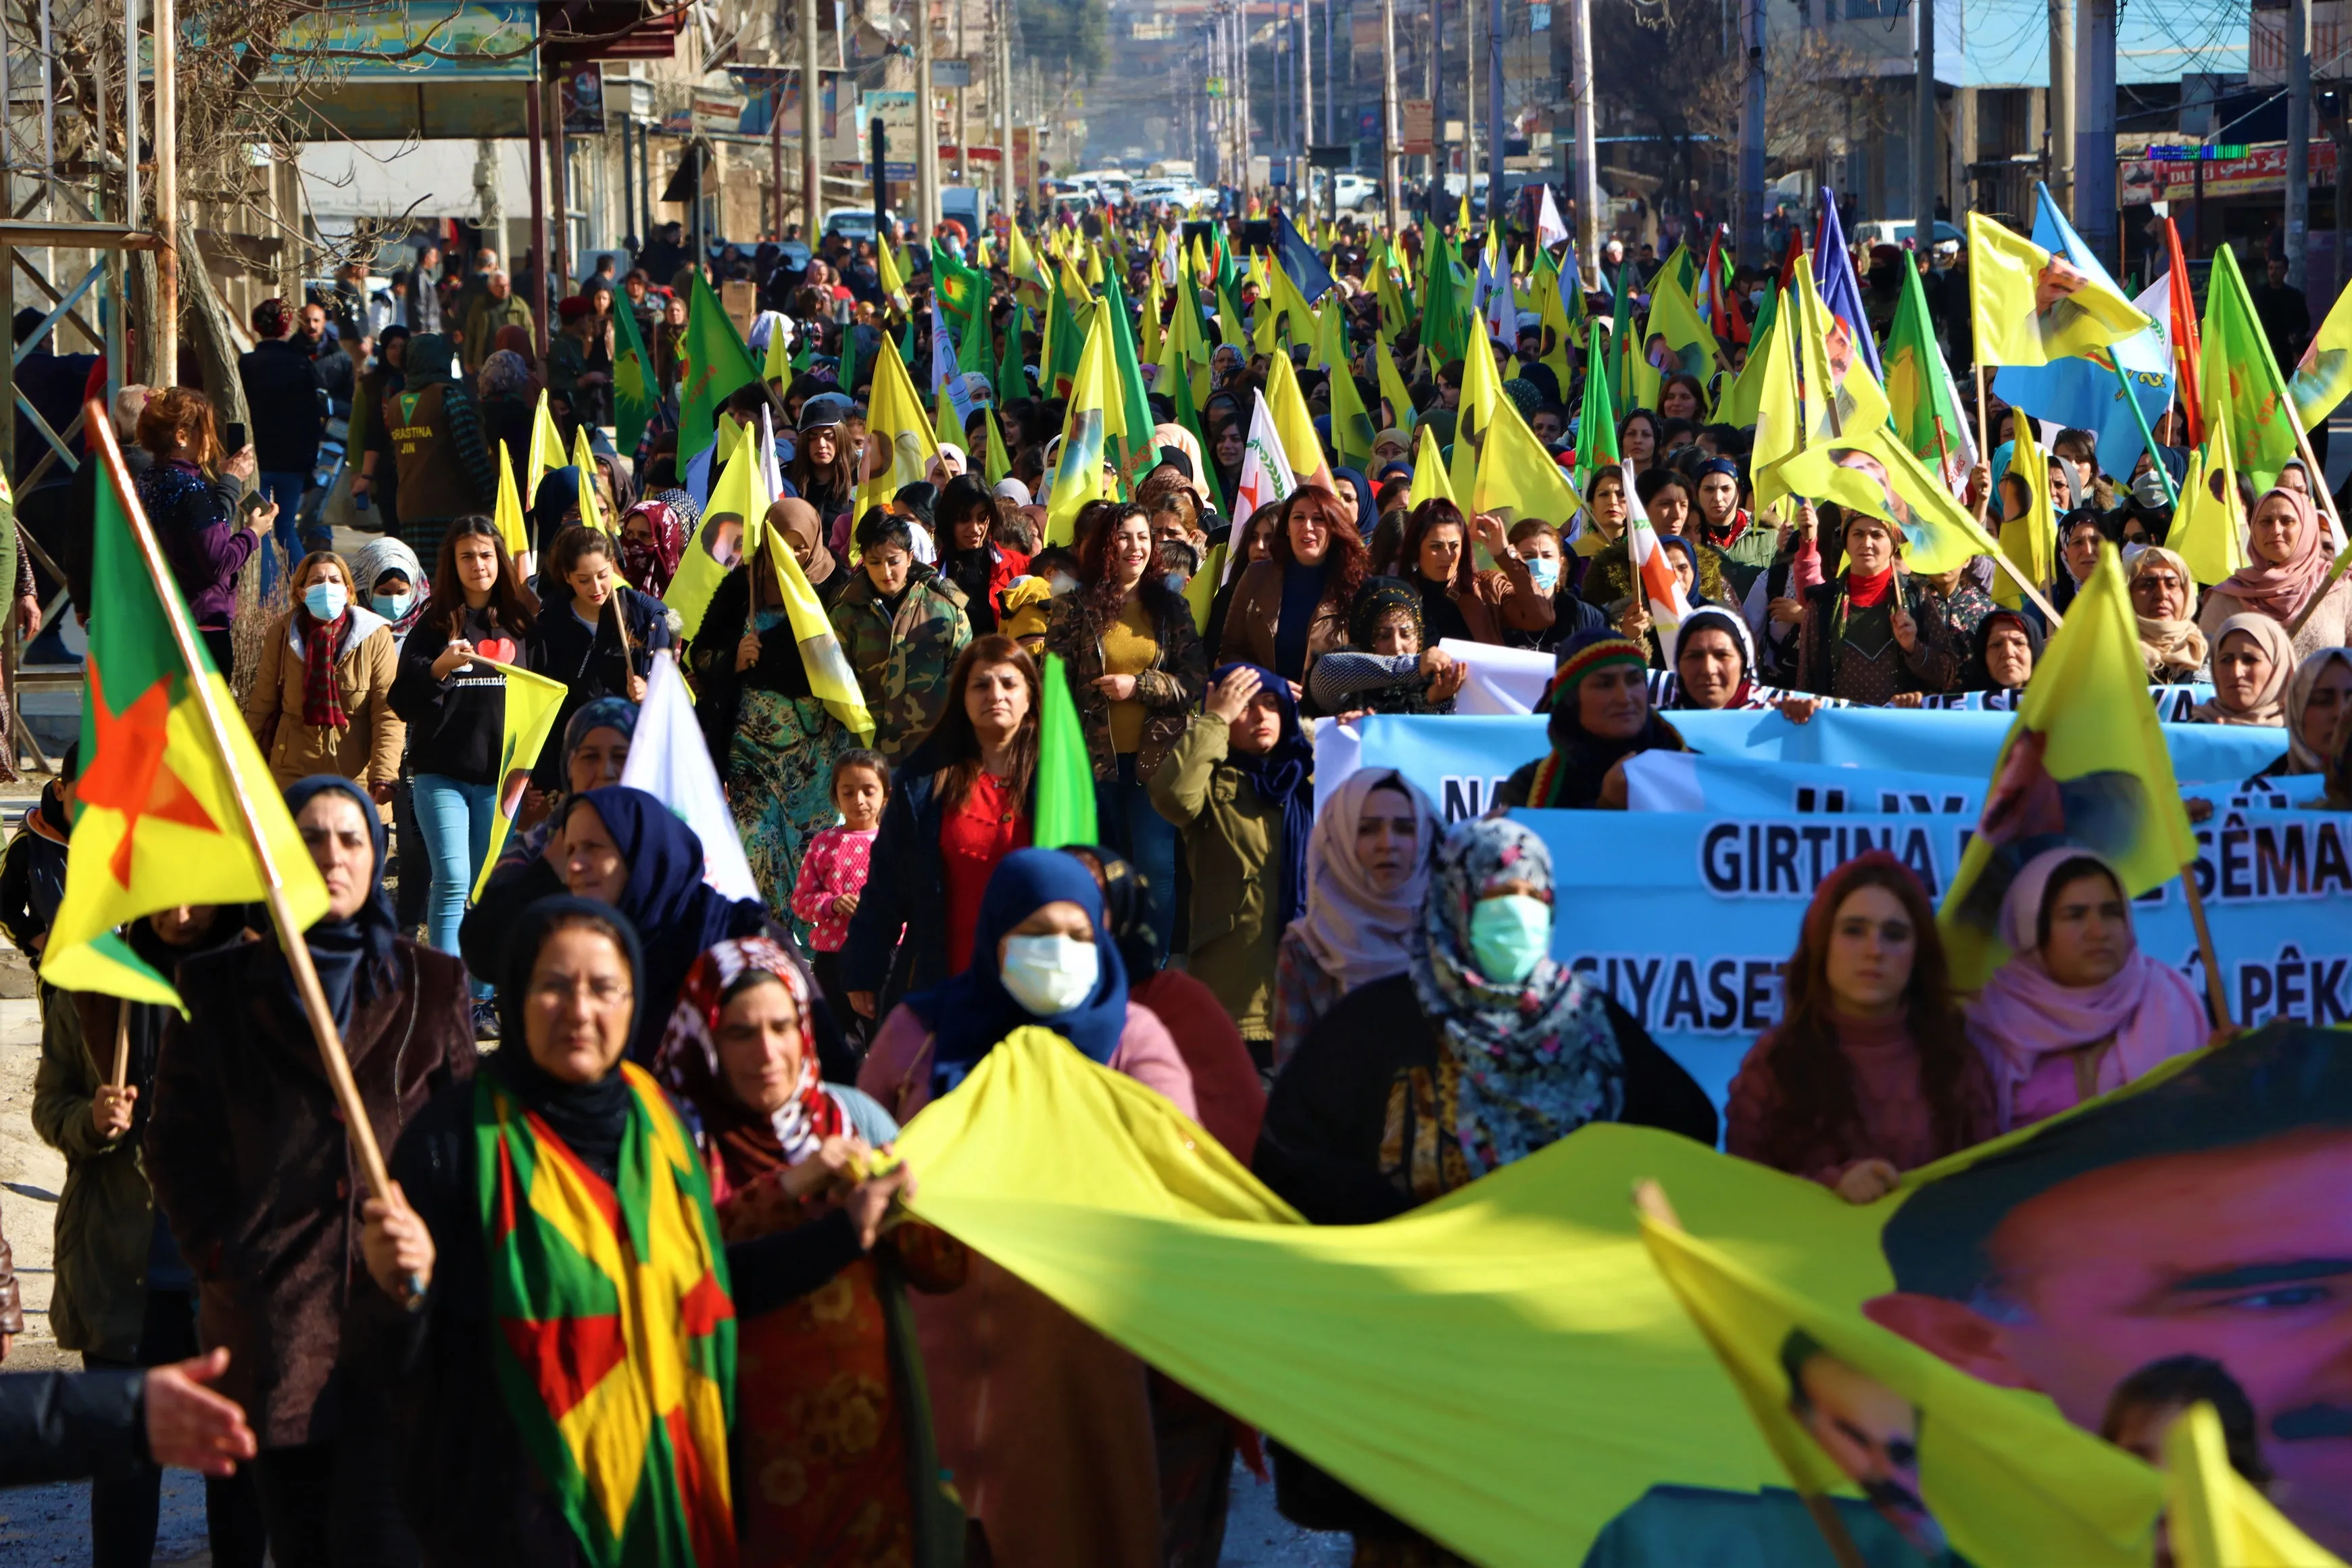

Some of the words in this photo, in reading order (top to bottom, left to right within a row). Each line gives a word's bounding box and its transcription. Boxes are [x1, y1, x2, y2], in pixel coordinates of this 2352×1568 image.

[401, 442, 416, 454] JIN
[1572, 956, 1788, 1029] IYASE
[2240, 946, 2352, 1027] PÊK
